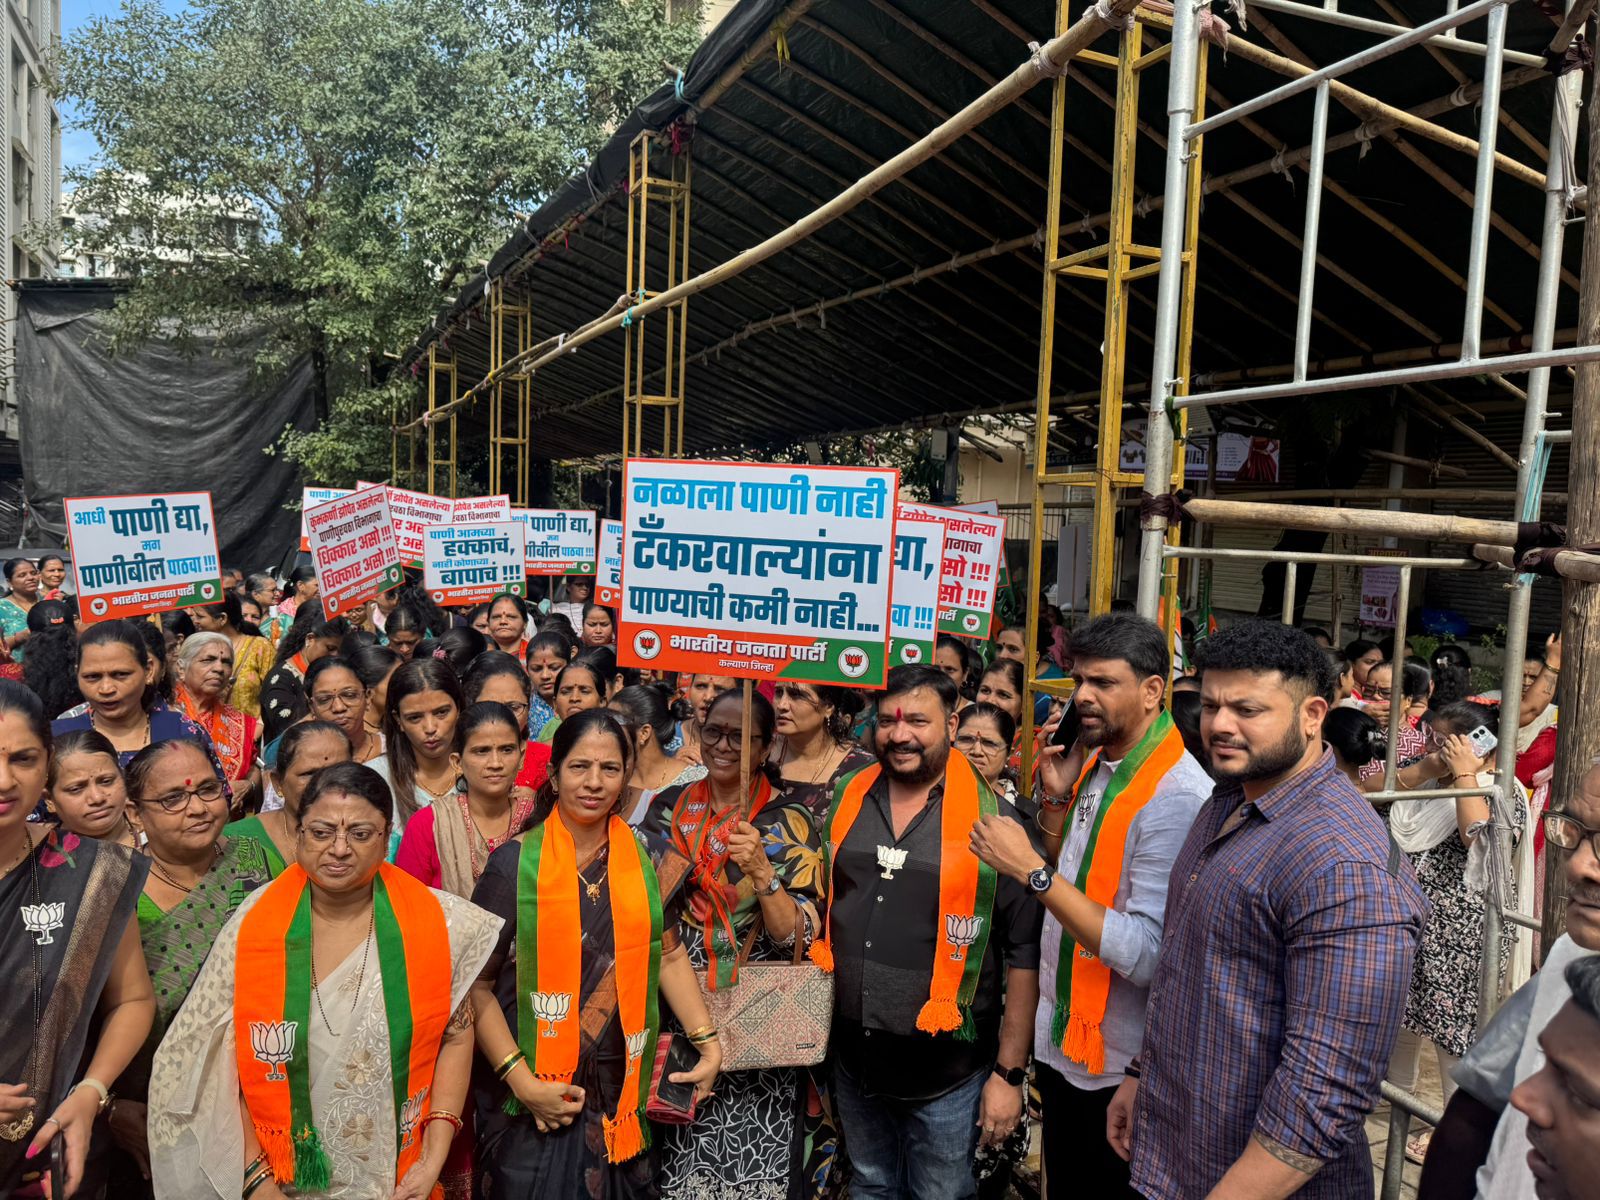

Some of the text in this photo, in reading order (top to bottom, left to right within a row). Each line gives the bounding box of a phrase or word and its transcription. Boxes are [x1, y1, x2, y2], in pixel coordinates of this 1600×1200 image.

[632, 474, 888, 519] नळाला पाणी नाही
[74, 498, 209, 537] आधी पाणी द्या,
[530, 512, 567, 533] पाणी
[940, 517, 997, 537] सलेल्या
[141, 540, 161, 551] मग
[358, 526, 381, 550] असो
[381, 525, 392, 542] !!!
[430, 527, 496, 540] पाणी आमच्या
[363, 548, 386, 571] असो
[385, 546, 397, 563] !!!
[561, 547, 584, 557] पाठवा
[585, 547, 594, 557] !!!
[79, 552, 217, 588] पाणीबील पाठवा !!!
[502, 564, 521, 581] !!!
[942, 554, 991, 582] सो !!!
[112, 591, 149, 605] भारतीय
[150, 589, 177, 600] जनता
[939, 580, 988, 608] सो !!!
[628, 583, 726, 621] पाण्याची
[729, 587, 791, 625] कमी
[794, 592, 880, 633] नाही...
[669, 633, 829, 662] भारतीय जनता पार्टी
[718, 659, 775, 672] कल्याण जिल्हा
